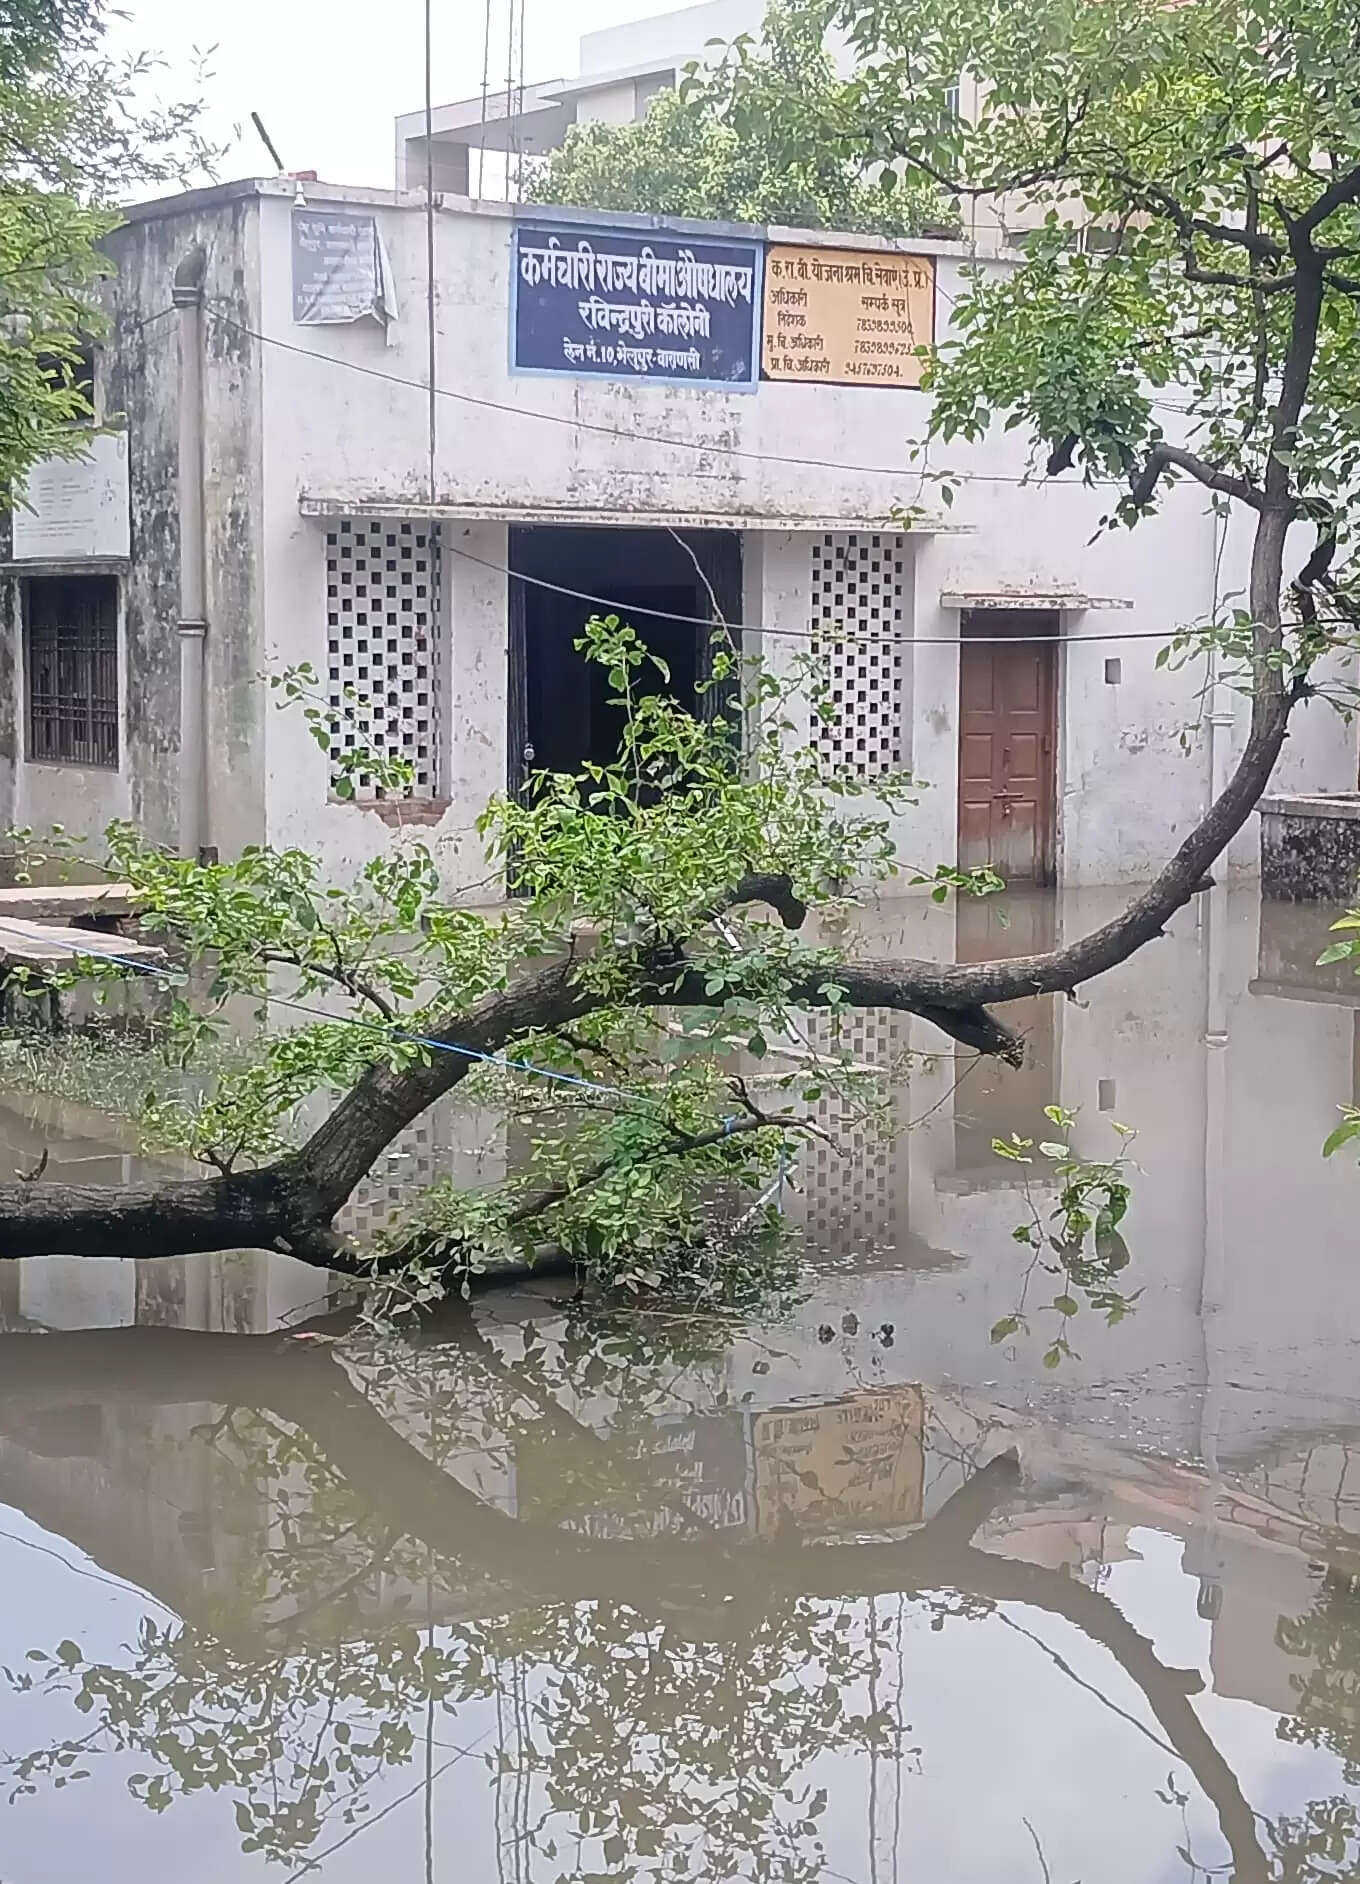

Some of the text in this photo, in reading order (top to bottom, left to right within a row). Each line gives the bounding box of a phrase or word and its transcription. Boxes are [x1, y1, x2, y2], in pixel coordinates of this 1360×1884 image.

[520, 236, 595, 292] कर्मचारी
[596, 253, 638, 295] राज्य
[811, 257, 844, 283] योजना
[770, 287, 808, 307] अधिकारी
[578, 295, 711, 340] रविन्द्रपुरी कॉलोनी
[563, 336, 585, 364] लेन
